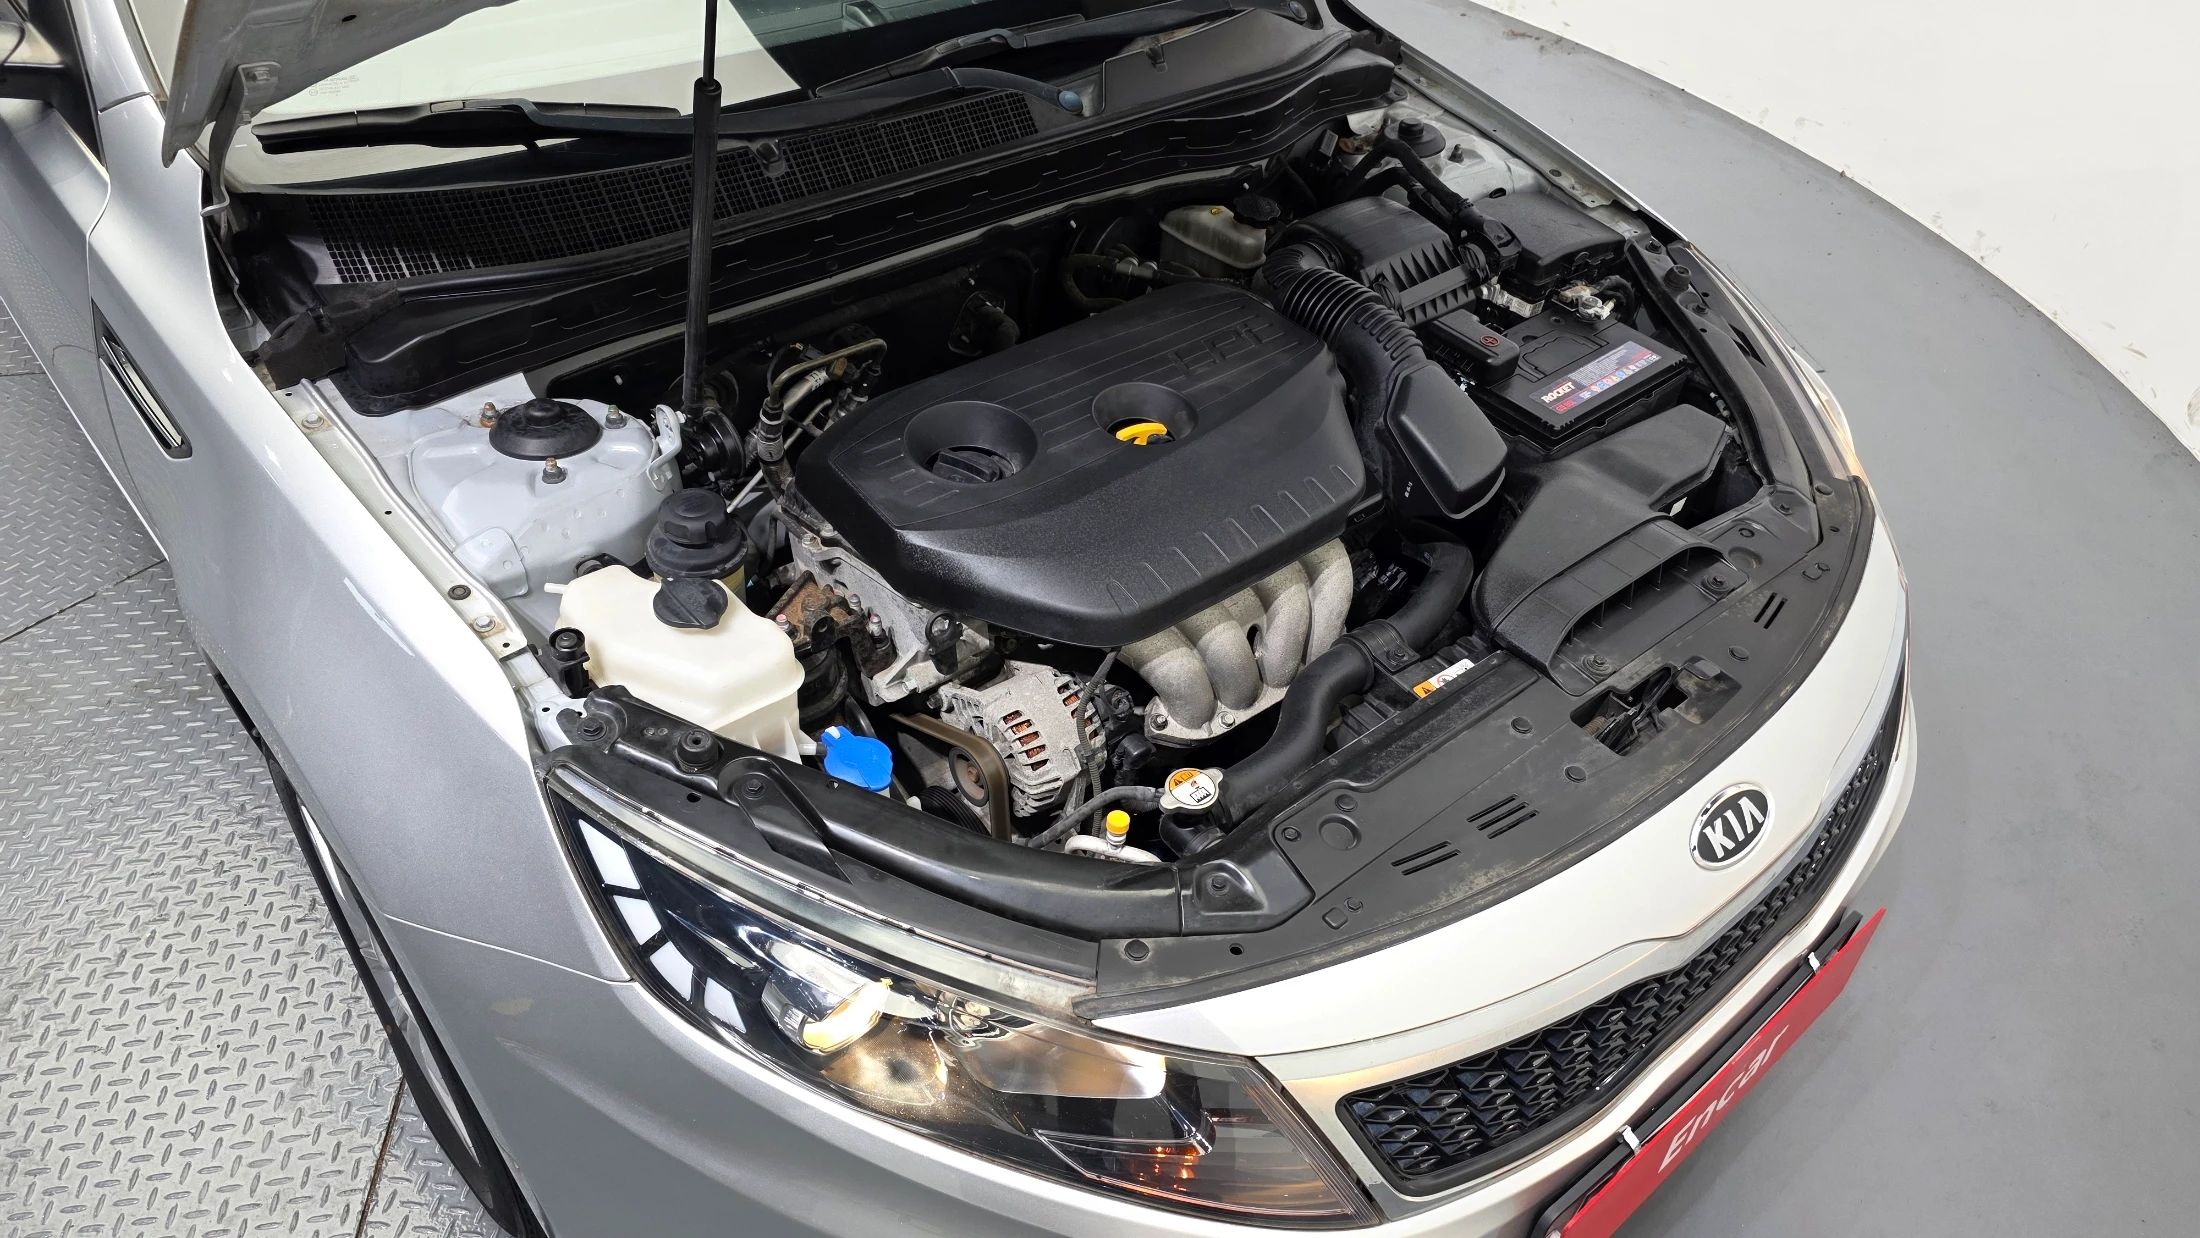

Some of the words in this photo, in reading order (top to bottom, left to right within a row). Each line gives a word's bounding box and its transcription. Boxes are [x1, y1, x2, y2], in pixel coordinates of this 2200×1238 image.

[1540, 381, 1576, 404] ROCKET
[1702, 796, 1765, 859] KIA
[1657, 1024, 1790, 1174] Encar
